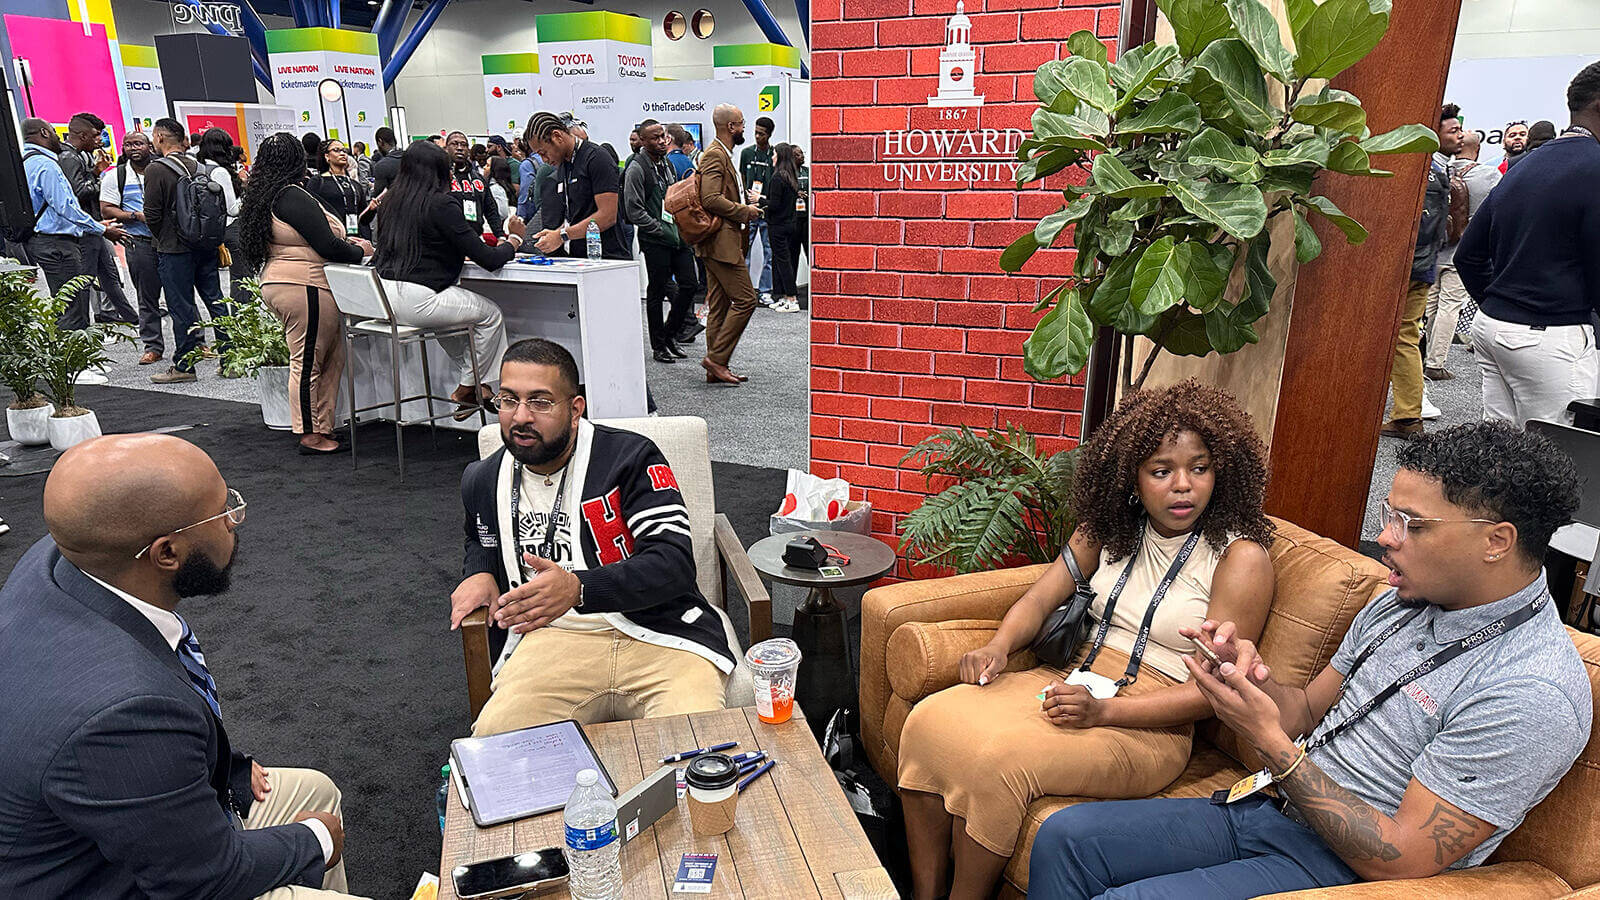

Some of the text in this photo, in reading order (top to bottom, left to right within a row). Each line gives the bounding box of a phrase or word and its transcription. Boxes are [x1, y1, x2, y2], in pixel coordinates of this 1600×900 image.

[552, 54, 594, 66] TOYOTA
[617, 54, 646, 67] TOYOTA
[277, 65, 319, 75] LIVE NATION
[334, 65, 375, 75] LIVE NATION
[563, 67, 595, 76] LEXUS
[625, 69, 647, 78] LEXUS
[126, 81, 151, 91] EICO
[280, 80, 319, 89] ticketmaster
[340, 79, 376, 90] icketmaster
[581, 96, 614, 104] AFROTECH
[938, 109, 968, 121] 1867
[253, 121, 273, 131] Shape
[883, 129, 1026, 156] HOWARD
[883, 162, 1022, 183] UNIVERSITY
[580, 486, 636, 567] H
[1179, 535, 1199, 563] AFROTECH
[1110, 572, 1129, 600] AFROTECH
[1152, 578, 1171, 607] AFROTECH
[1093, 618, 1108, 650] AFROTECH
[1461, 620, 1506, 648] AFROTECH
[1135, 625, 1149, 659] AFROTECH
[1396, 658, 1435, 687] AFROTECH
[1342, 700, 1376, 727] AFROTECH
